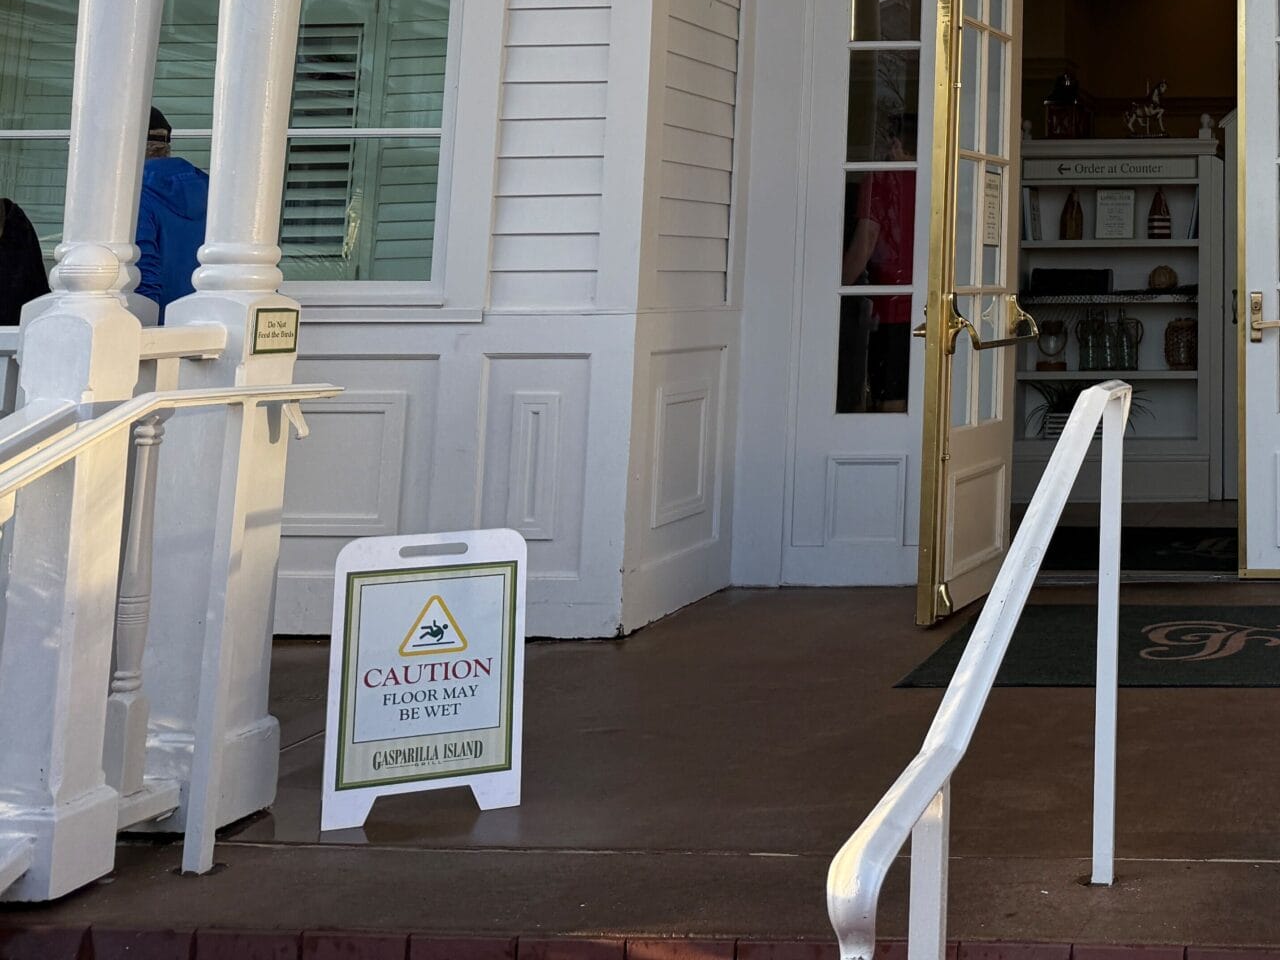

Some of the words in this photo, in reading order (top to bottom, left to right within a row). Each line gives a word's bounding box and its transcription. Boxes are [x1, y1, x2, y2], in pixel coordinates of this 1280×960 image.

[1074, 163, 1105, 174] Order
[1108, 165, 1117, 174] at
[1120, 163, 1164, 174] Counter
[277, 320, 287, 328] Not
[258, 331, 270, 339] Feed
[364, 657, 493, 688] CAUTION
[383, 689, 439, 706] FLOOR
[442, 685, 479, 701] MAY
[399, 707, 421, 721] BE
[424, 702, 462, 718] WET
[372, 745, 439, 771] GASPARILLA
[443, 740, 484, 759] ISLAND
